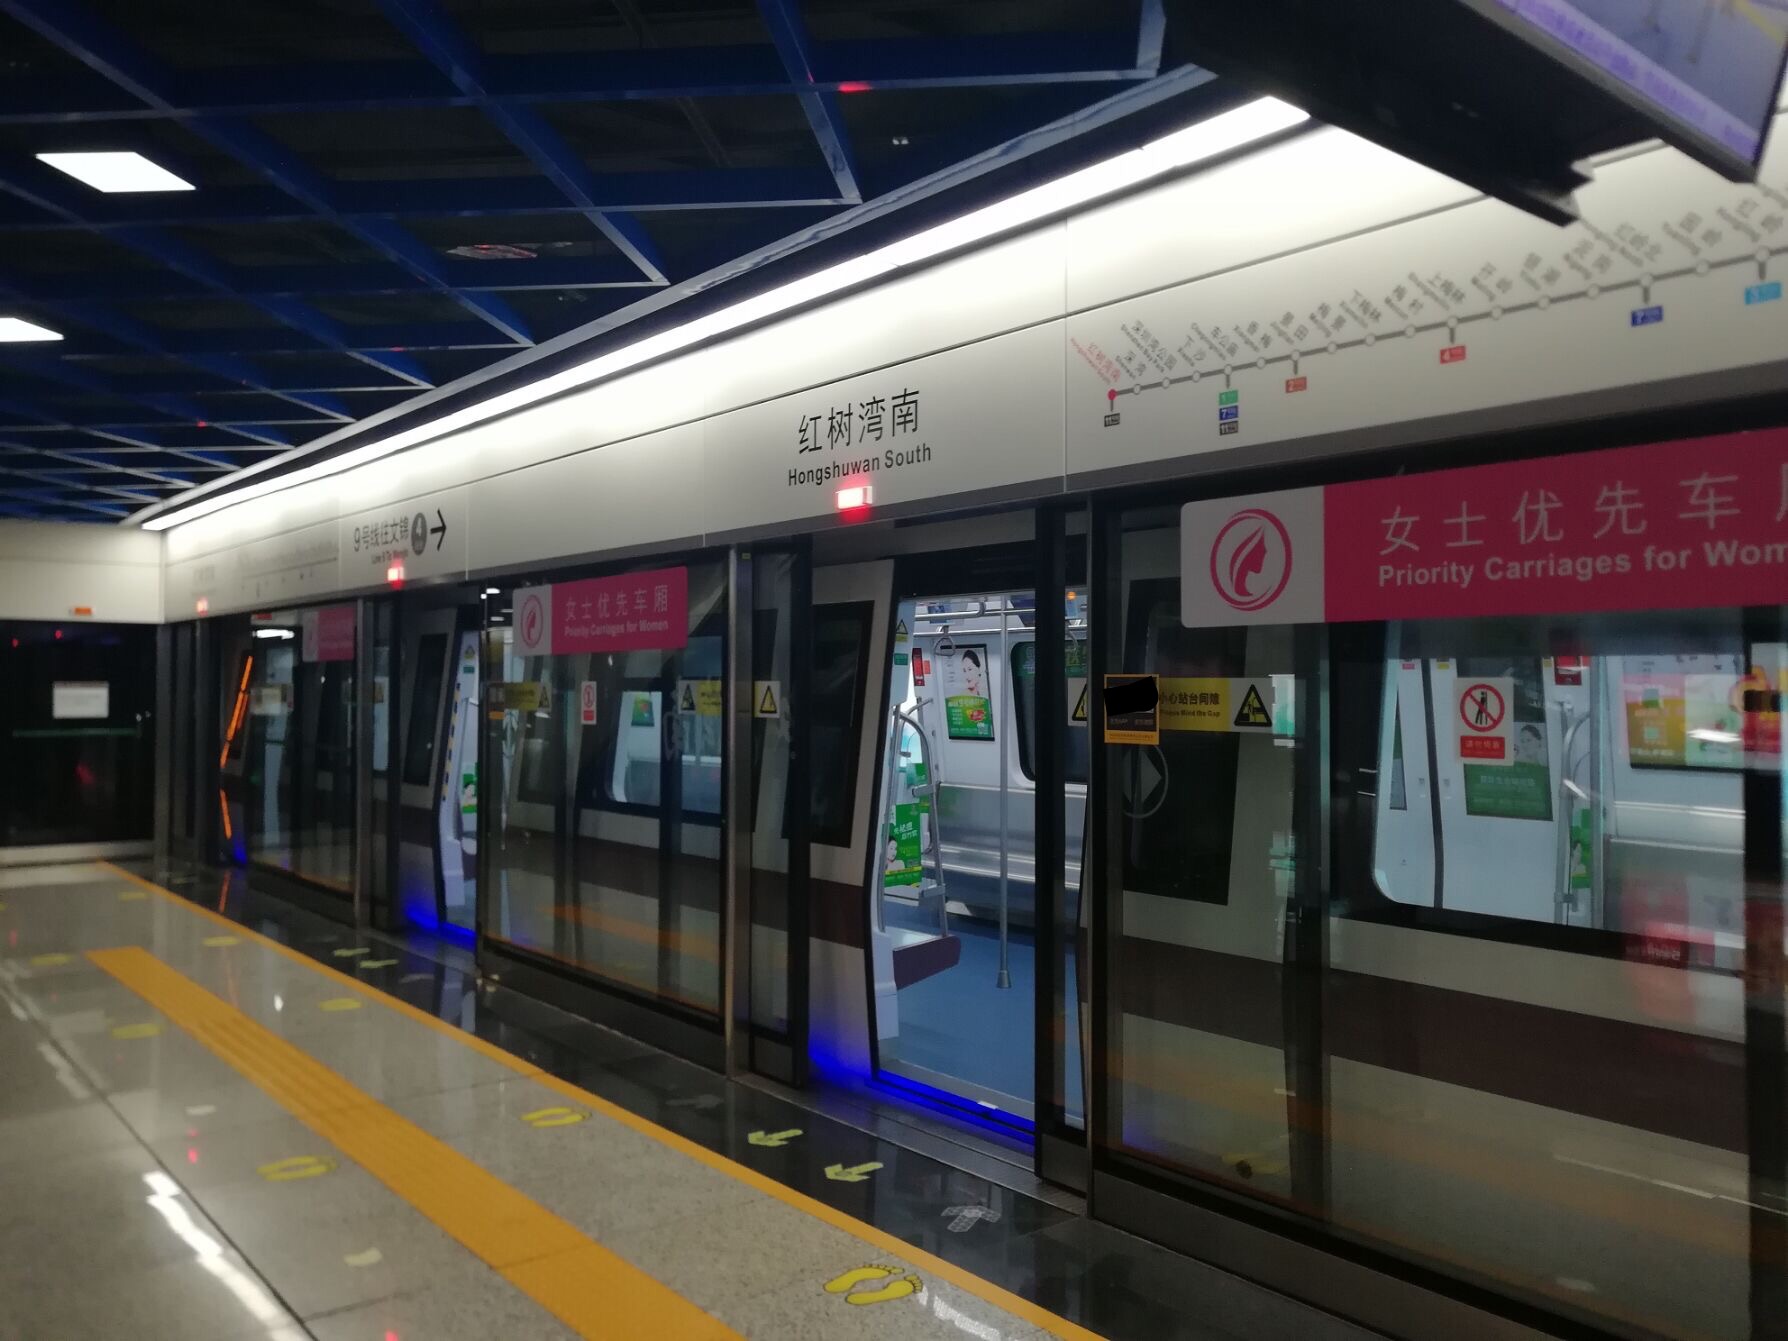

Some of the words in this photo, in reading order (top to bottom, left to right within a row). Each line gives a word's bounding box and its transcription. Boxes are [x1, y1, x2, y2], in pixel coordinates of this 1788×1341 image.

[798, 387, 919, 455] 红树湾南
[788, 456, 880, 486] Hongshuwan
[884, 443, 932, 469] South
[1379, 561, 1474, 588] Priority
[1484, 553, 1631, 581] Carriages
[1644, 545, 1692, 571] for
[564, 584, 668, 622] 女士优先车厢
[564, 625, 589, 639] Priority
[591, 623, 625, 637] Carriages
[626, 620, 638, 633] for
[639, 619, 669, 633] Women
